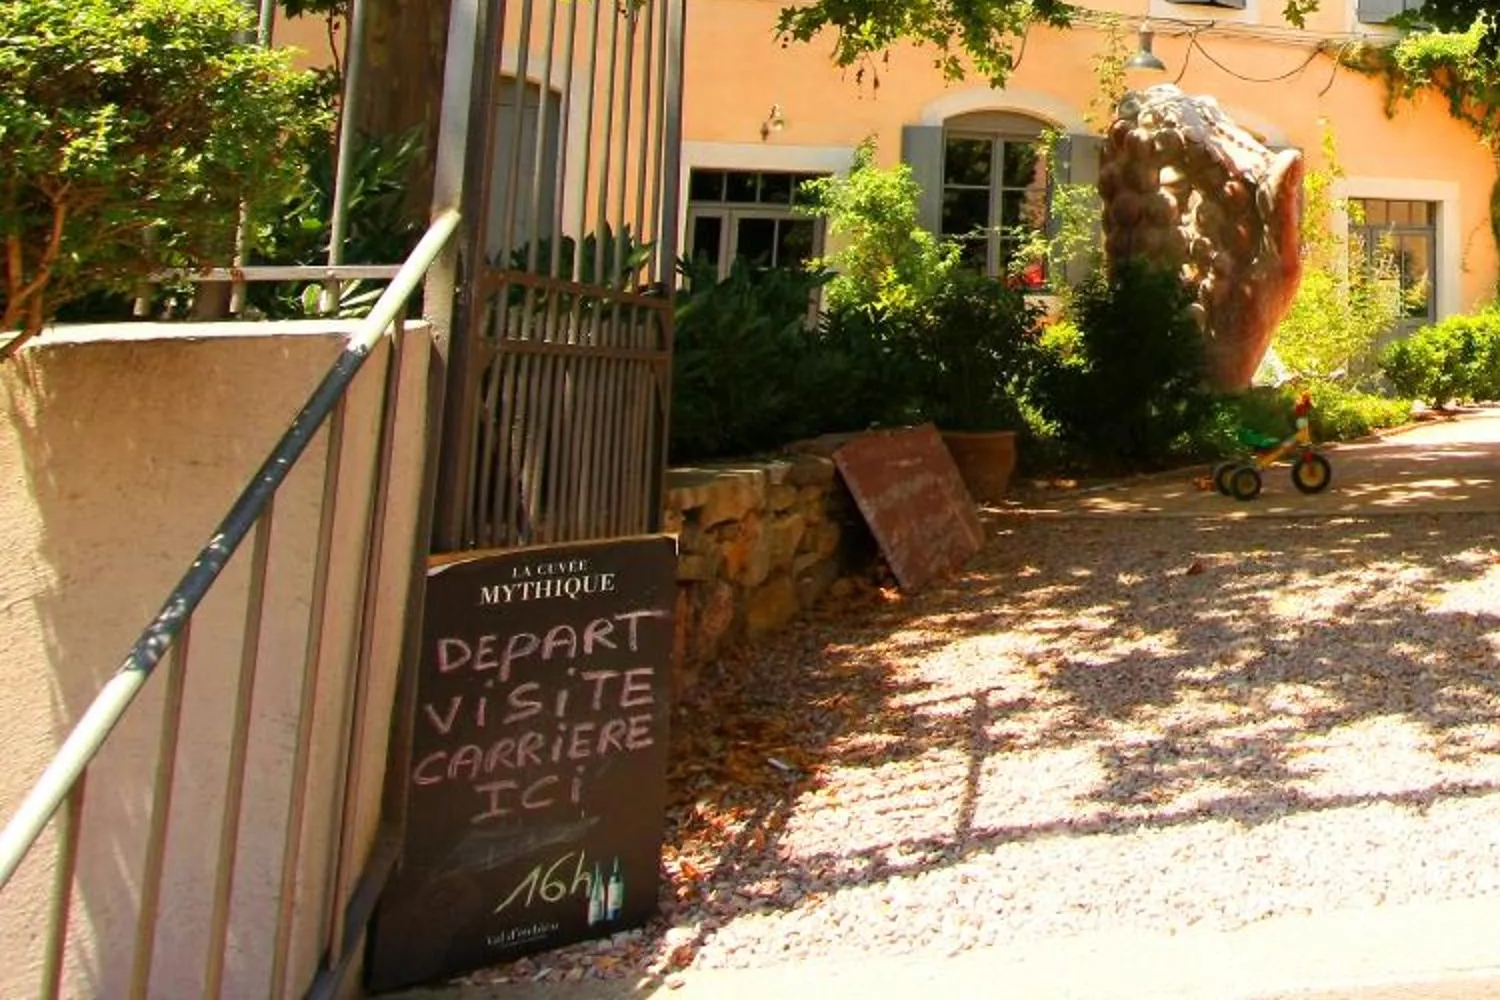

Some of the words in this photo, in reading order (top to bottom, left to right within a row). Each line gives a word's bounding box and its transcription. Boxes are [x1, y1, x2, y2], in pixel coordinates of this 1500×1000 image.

[480, 573, 616, 605] MYTHIQUE
[437, 610, 670, 682] DEPART
[494, 849, 593, 915] 16h
